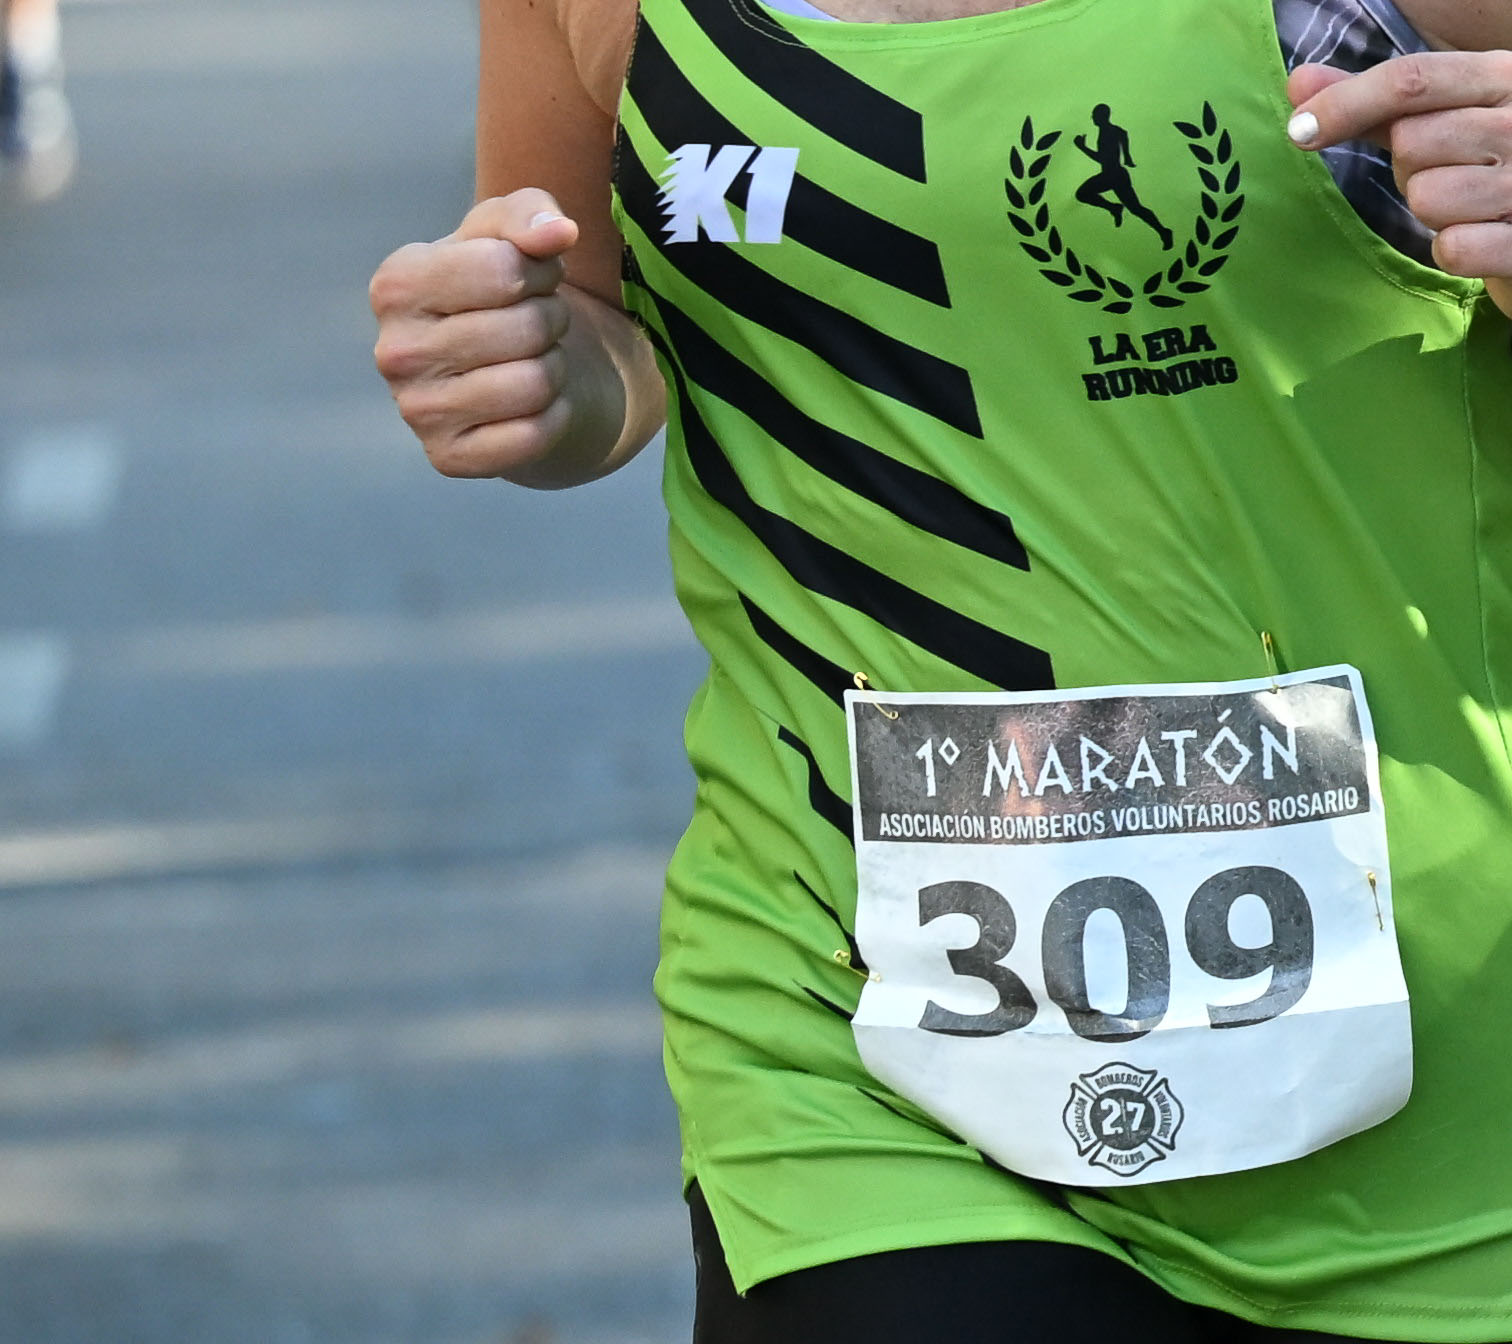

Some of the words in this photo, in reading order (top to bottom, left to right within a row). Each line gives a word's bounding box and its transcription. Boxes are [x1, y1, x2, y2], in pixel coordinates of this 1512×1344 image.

[1088, 333, 1142, 365] LA
[1141, 324, 1217, 362] ERA
[1081, 356, 1239, 401] RUNNING
[982, 709, 1299, 797] MARATÓN
[879, 808, 985, 838] ASOCIACIÓN
[990, 809, 1105, 840] BOMBEROS
[1110, 800, 1262, 832] VOLUNTARIOS
[1268, 785, 1359, 821] ROSARIO
[917, 865, 1314, 1043] 309
[1100, 1097, 1146, 1135] 27
